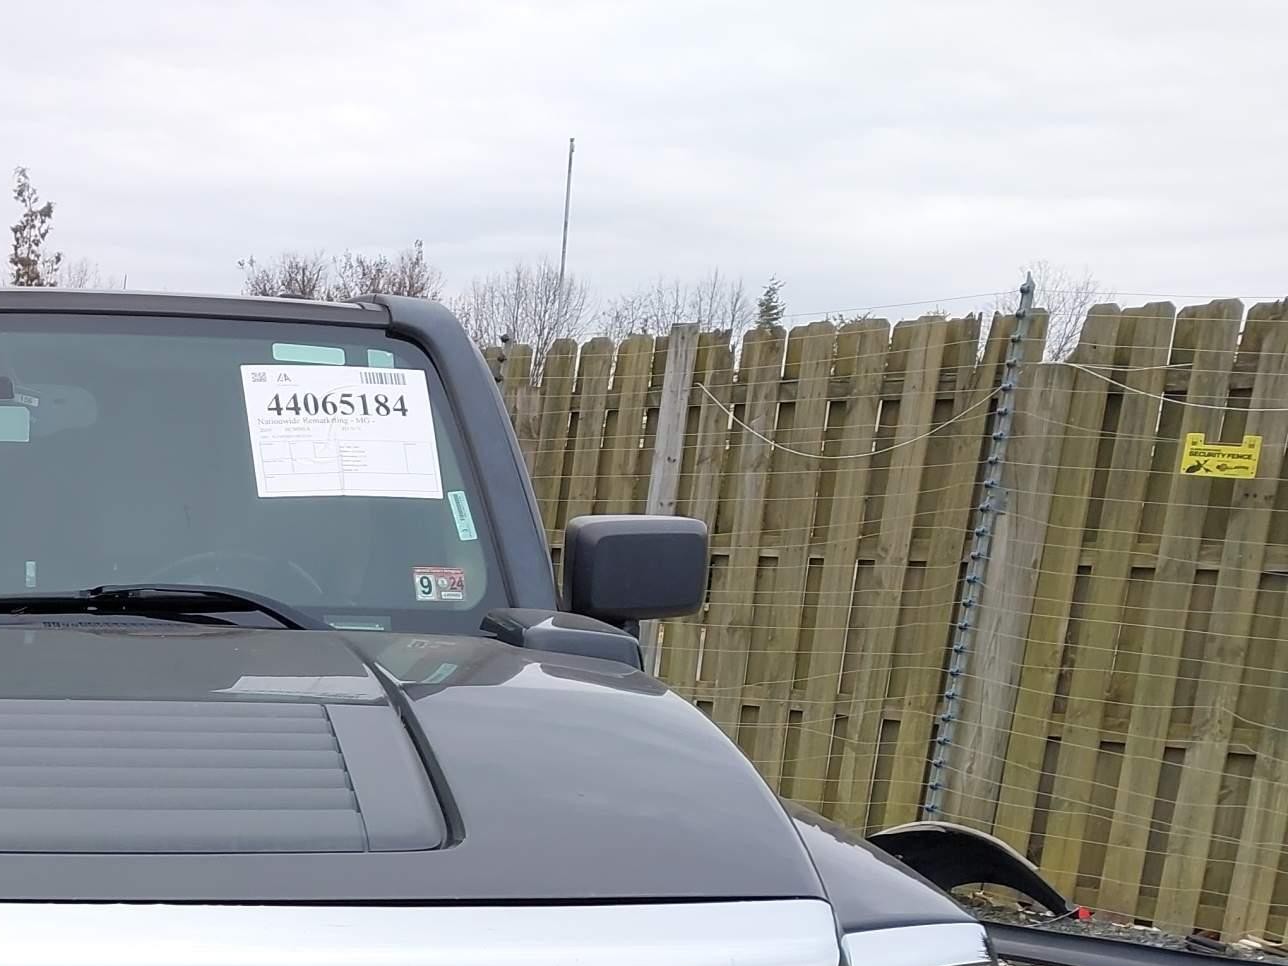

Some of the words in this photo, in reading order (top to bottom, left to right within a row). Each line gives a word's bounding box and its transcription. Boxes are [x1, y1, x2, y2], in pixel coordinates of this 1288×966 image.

[267, 392, 409, 417] 44065184
[1189, 451, 1226, 459] SECURITY
[420, 576, 432, 595] 9
[449, 576, 464, 590] 24
